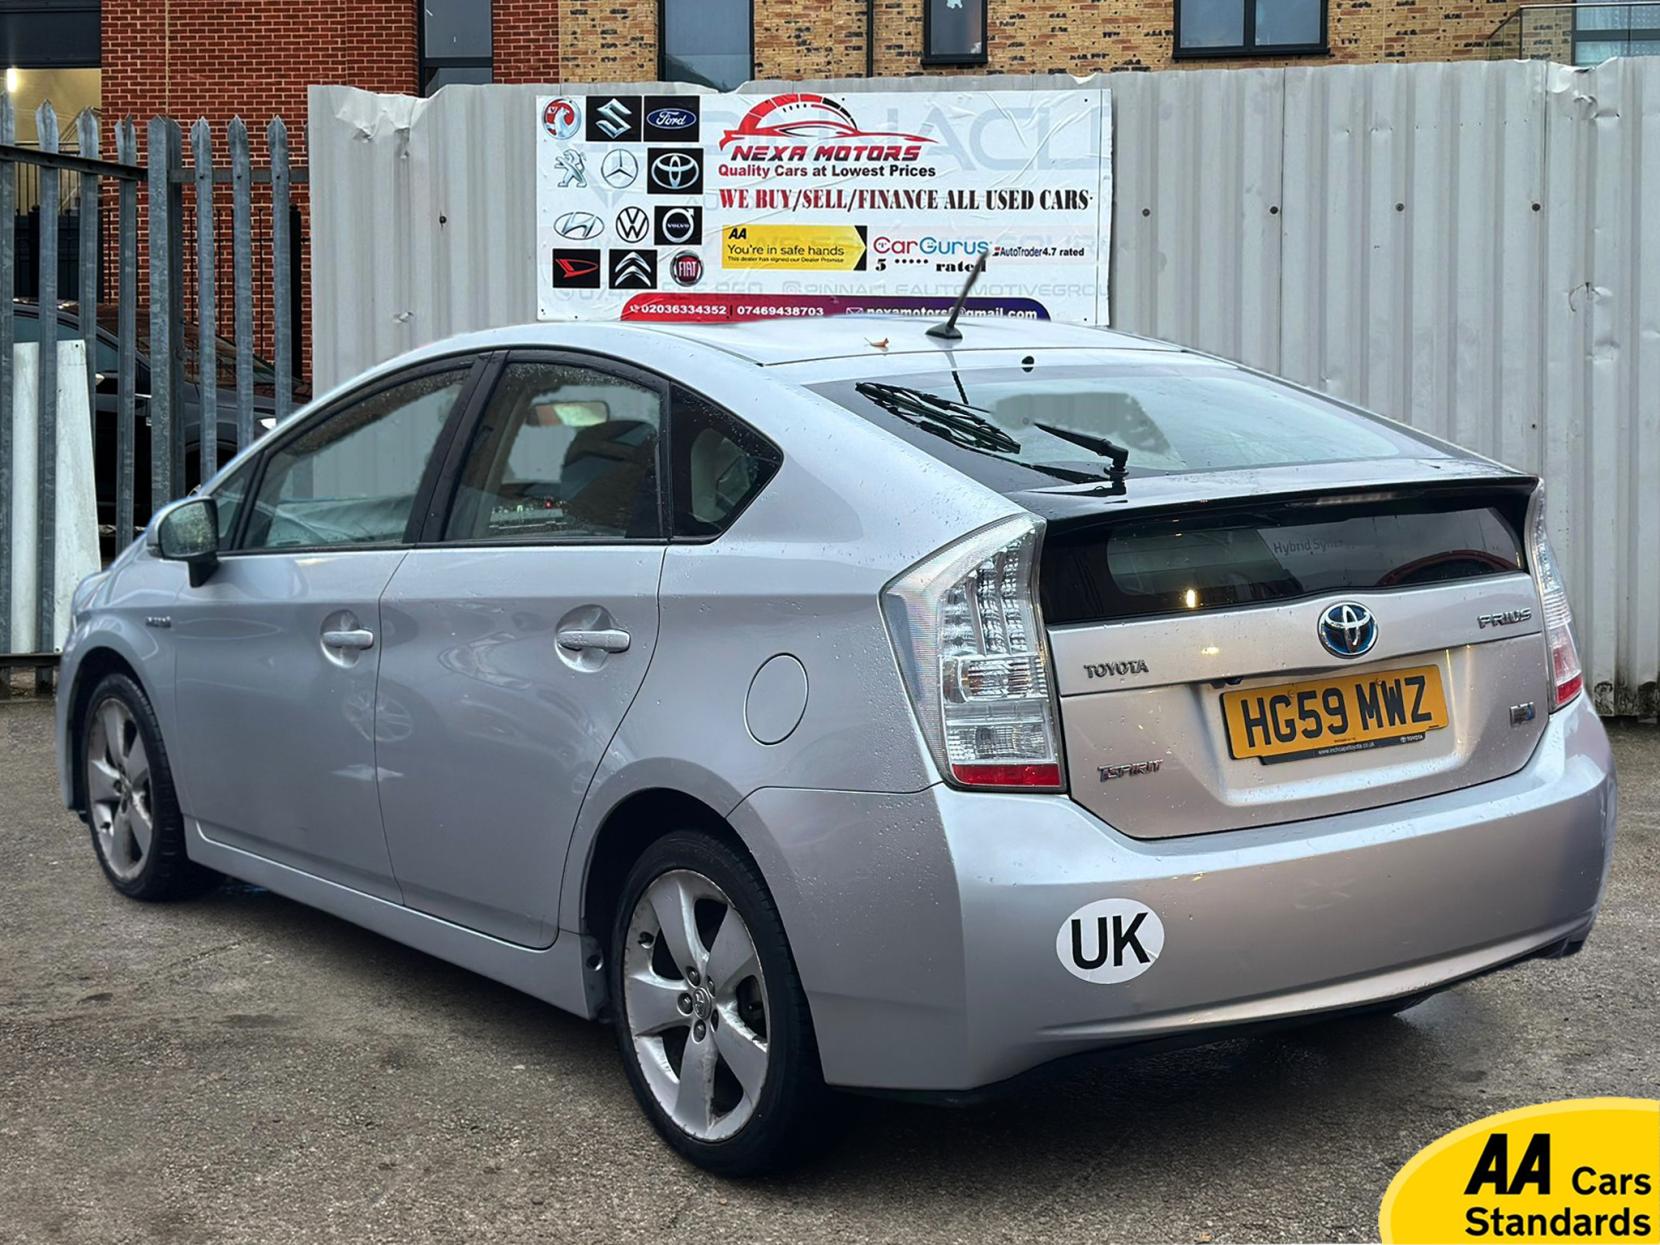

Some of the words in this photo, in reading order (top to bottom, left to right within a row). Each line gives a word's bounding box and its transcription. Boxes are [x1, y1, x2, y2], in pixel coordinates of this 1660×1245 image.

[656, 111, 688, 126] Ford
[730, 145, 807, 162] NEXA
[813, 145, 922, 162] MOTORS
[718, 163, 770, 179] Quality
[775, 165, 808, 177] Cars
[812, 165, 827, 177] at
[832, 164, 885, 177] Lowest
[889, 164, 937, 177] Prices
[719, 189, 749, 209] WE
[944, 189, 980, 210] ALL
[985, 189, 1035, 210] USED
[728, 228, 747, 240] AA
[727, 244, 764, 255] You're
[766, 244, 778, 255] in
[780, 244, 806, 256] safe
[807, 245, 845, 256] hands
[873, 236, 990, 255] CarGurus
[1058, 247, 1085, 257] rated
[678, 261, 697, 277] FIAT
[875, 258, 887, 271] 5
[641, 304, 727, 314] 02036334352
[736, 306, 824, 316] 07469438703
[1273, 539, 1311, 556] Hybrid
[1476, 607, 1533, 629] PRIUS
[1083, 659, 1149, 679] TOYOTA
[1241, 687, 1349, 748] HG59
[1355, 675, 1433, 731] MWZ
[1071, 911, 1151, 970] UK
